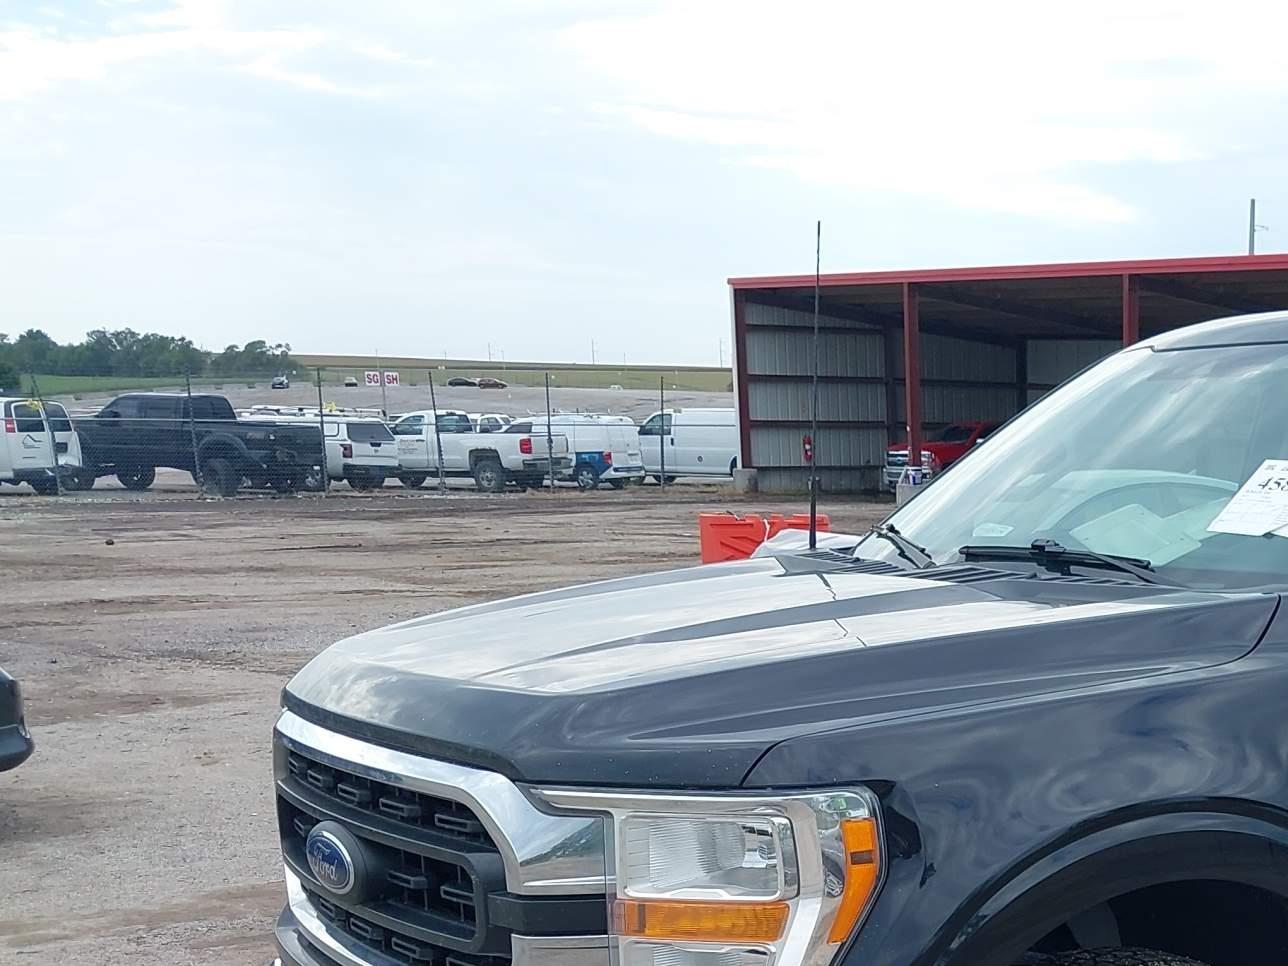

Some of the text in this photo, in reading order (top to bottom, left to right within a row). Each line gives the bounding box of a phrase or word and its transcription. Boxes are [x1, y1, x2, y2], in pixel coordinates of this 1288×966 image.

[366, 373, 379, 384] SG
[385, 374, 399, 385] SH
[312, 842, 338, 881] Ford
